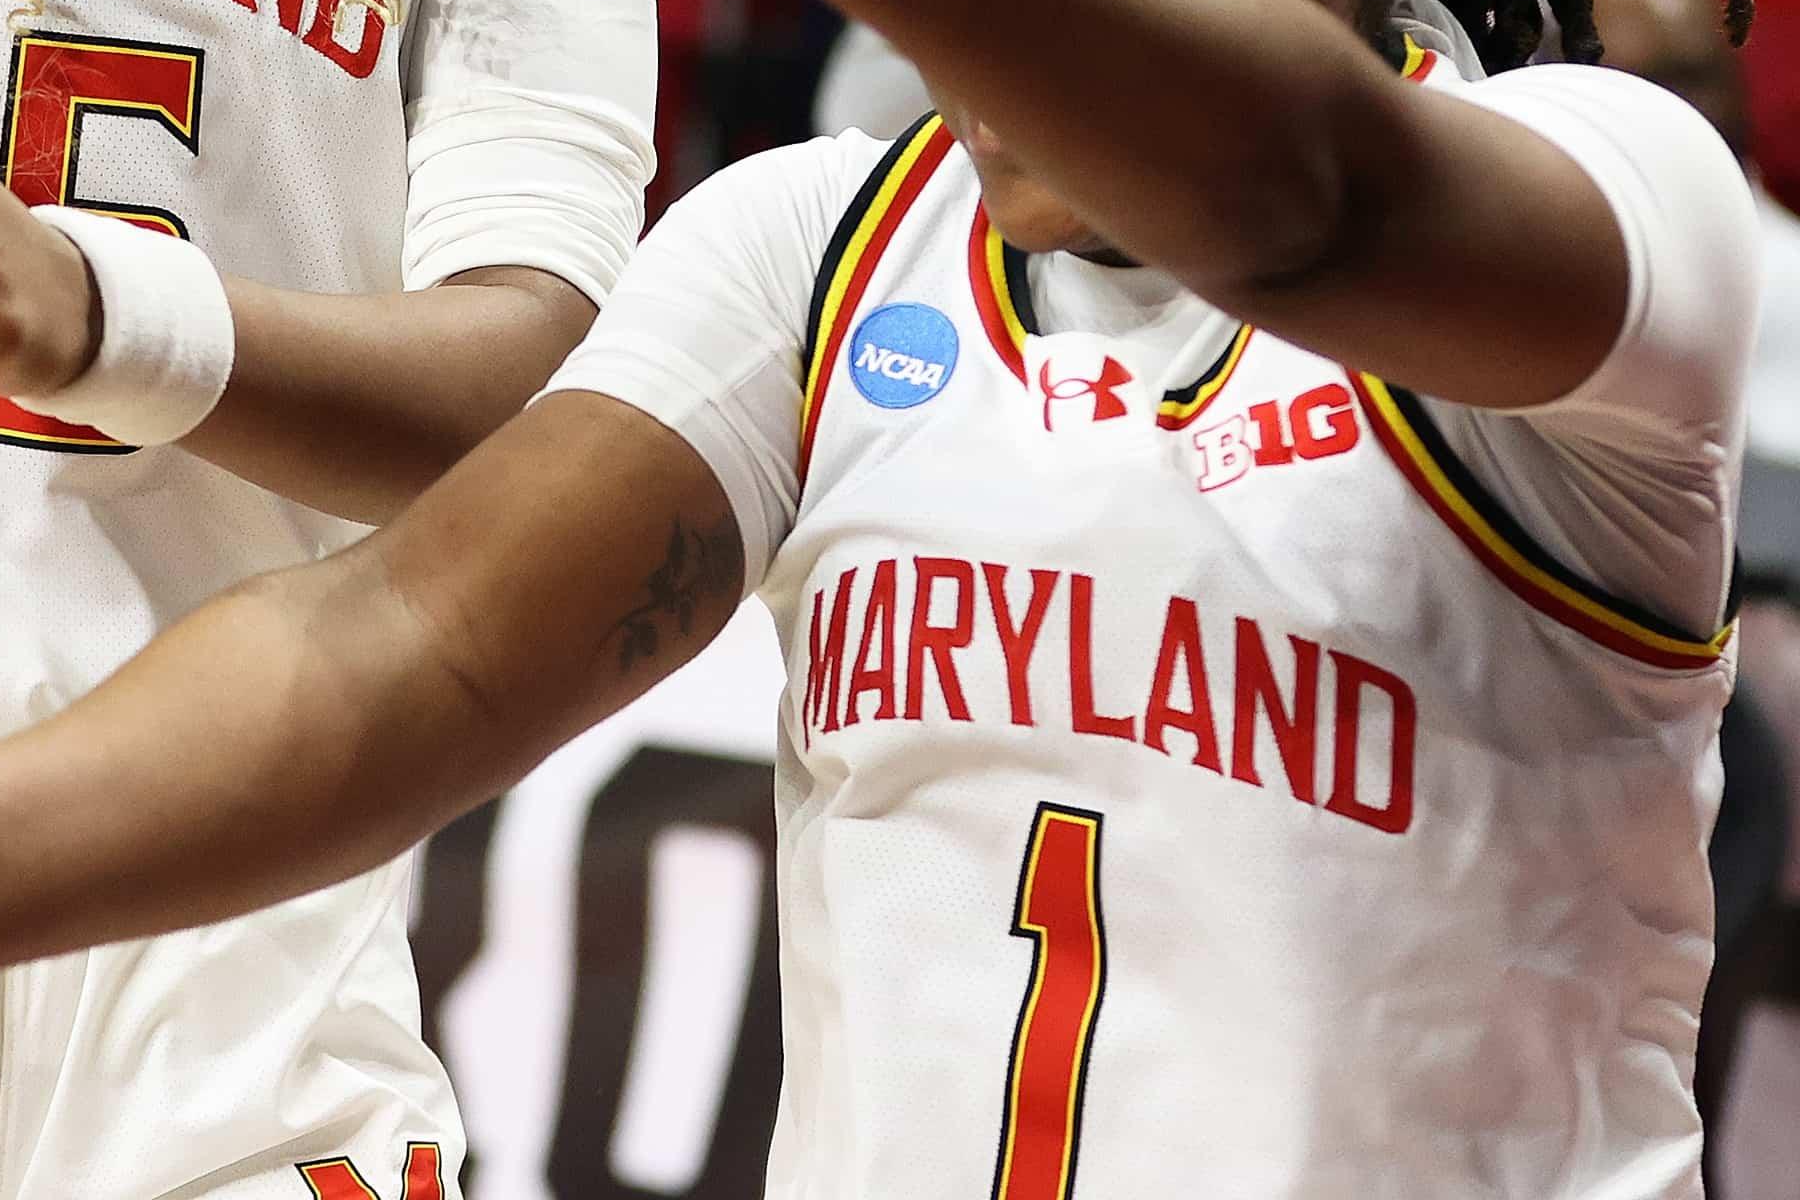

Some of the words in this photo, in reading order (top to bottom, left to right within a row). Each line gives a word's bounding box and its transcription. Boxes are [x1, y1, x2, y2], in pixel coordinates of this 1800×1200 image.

[854, 342, 946, 390] NCAA
[803, 555, 1417, 836] MARYLAND
[992, 801, 1105, 1200] 1
